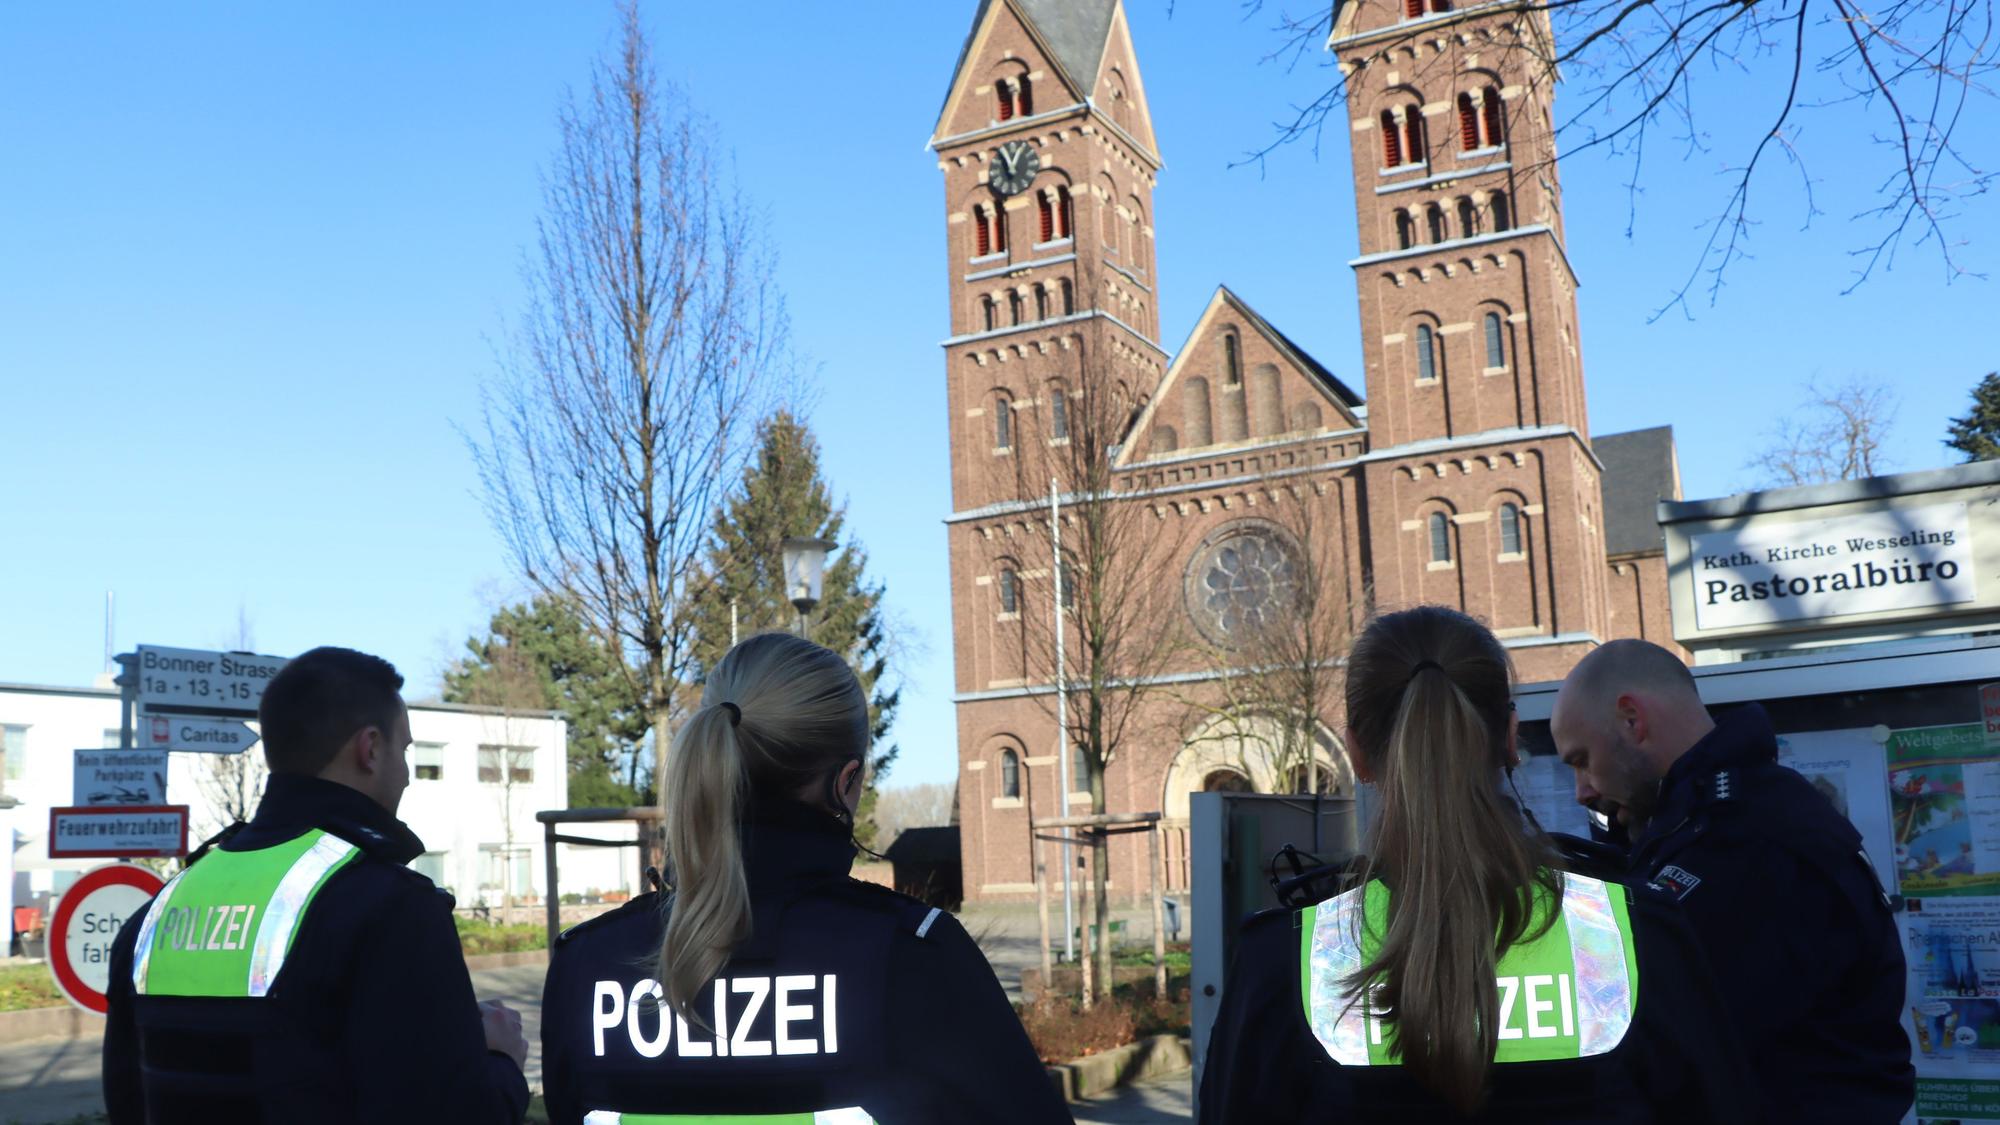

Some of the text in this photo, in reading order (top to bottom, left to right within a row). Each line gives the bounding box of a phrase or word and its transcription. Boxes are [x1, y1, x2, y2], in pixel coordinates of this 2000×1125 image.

[1703, 529, 1955, 570] Kath. Kirche Wesseling
[1705, 558, 1959, 605] Pastoralbüro
[144, 651, 214, 674] Bonner
[144, 675, 167, 694] 1a
[187, 678, 211, 697] 13
[229, 681, 251, 700] 15
[180, 726, 239, 744] Caritas
[94, 768, 145, 784] Parkplatz
[58, 818, 180, 837] Feuerwehrzufahrt
[81, 911, 125, 934] Sch
[159, 904, 256, 951] POLIZEI
[593, 974, 838, 1058] POLIZEI
[1369, 973, 1574, 1045] PZEI
